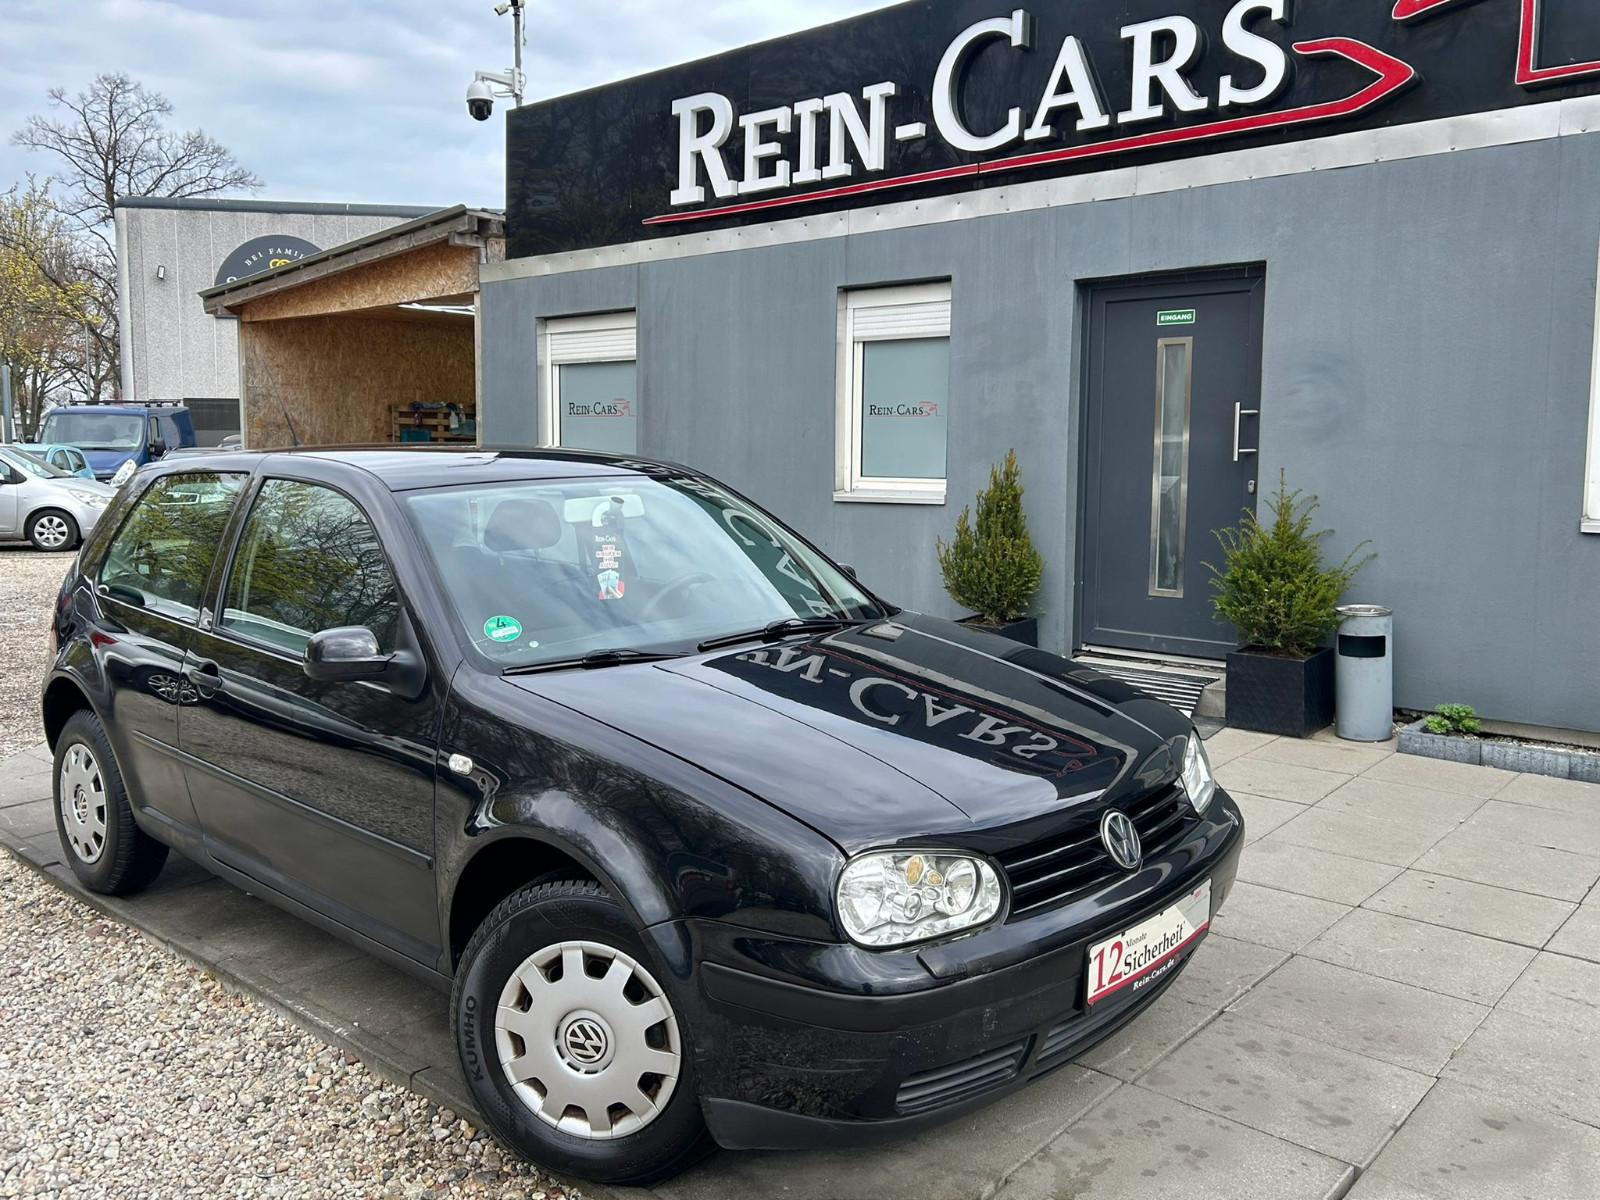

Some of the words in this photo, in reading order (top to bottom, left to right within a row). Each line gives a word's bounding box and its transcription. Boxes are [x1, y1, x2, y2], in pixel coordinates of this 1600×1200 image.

[671, 0, 1289, 206] REIN-CARS
[244, 251, 263, 266] BEI
[1160, 313, 1192, 322] EINGANG
[496, 617, 507, 629] 4
[1125, 932, 1148, 948] Monate
[1093, 940, 1124, 993] 12
[1132, 958, 1175, 991] Rein-Cars.de
[462, 995, 484, 1082] KUMHO
